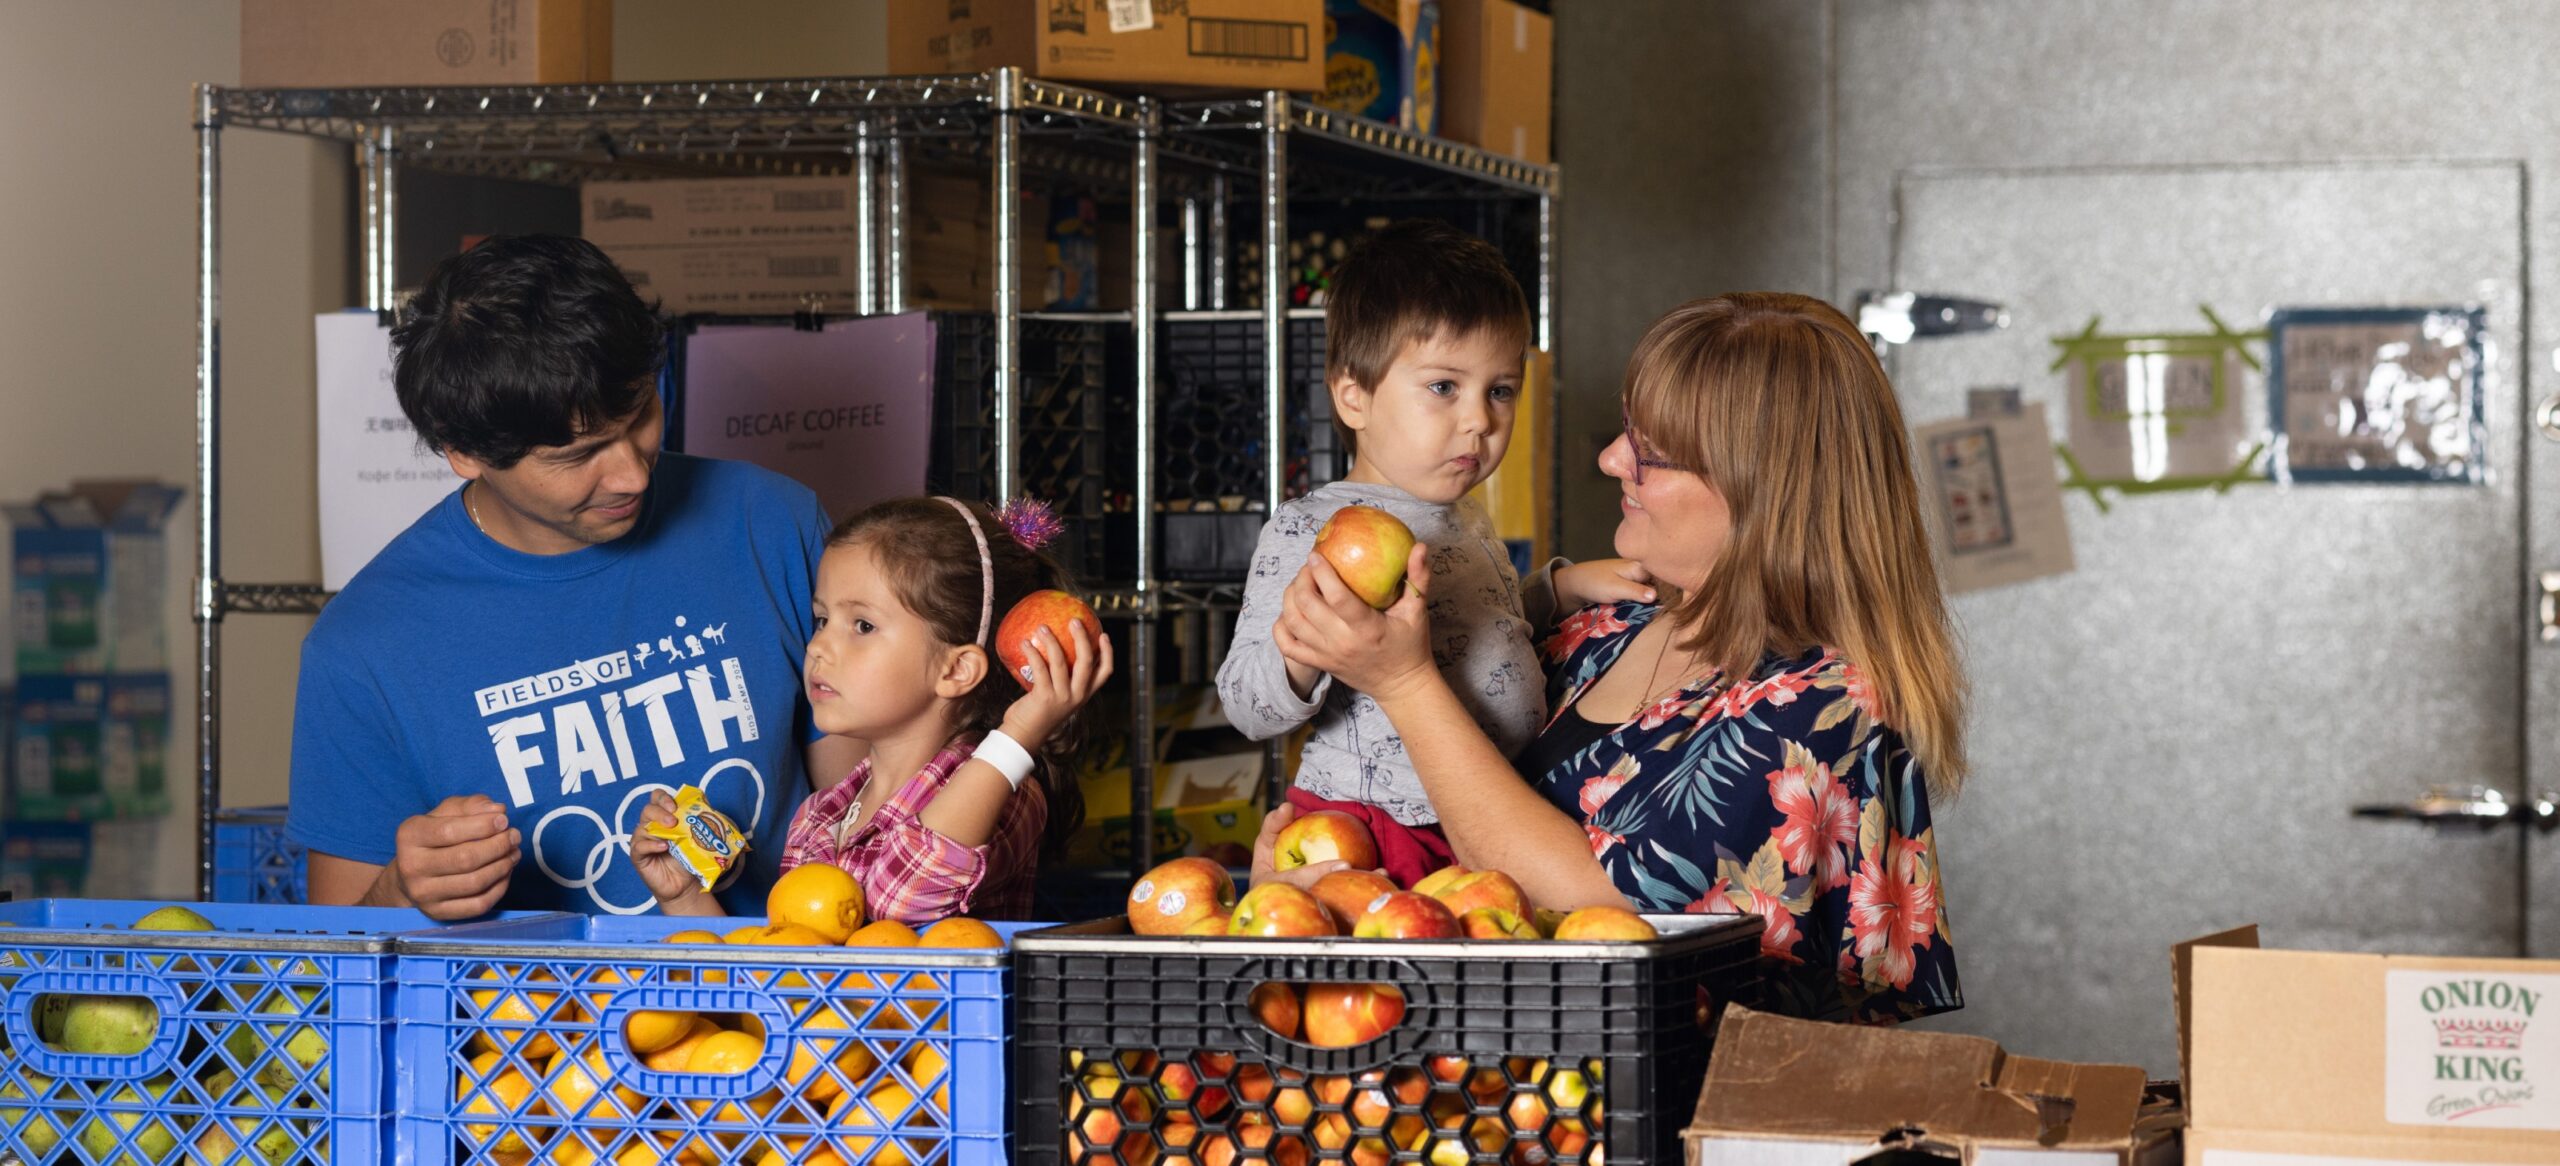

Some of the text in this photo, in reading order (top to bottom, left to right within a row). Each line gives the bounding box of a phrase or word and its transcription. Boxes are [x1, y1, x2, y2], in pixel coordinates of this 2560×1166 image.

[725, 403, 886, 439] DECAF COFFEE
[394, 466, 417, 480] без
[484, 655, 627, 710] FIELDS OF
[731, 658, 757, 738] KIDS CAMP 2021
[487, 657, 760, 809] FAITH
[687, 816, 730, 854] OREO
[2420, 979, 2542, 1018] ONION
[2434, 1054, 2524, 1083] KING
[2426, 1095, 2477, 1118] Green
